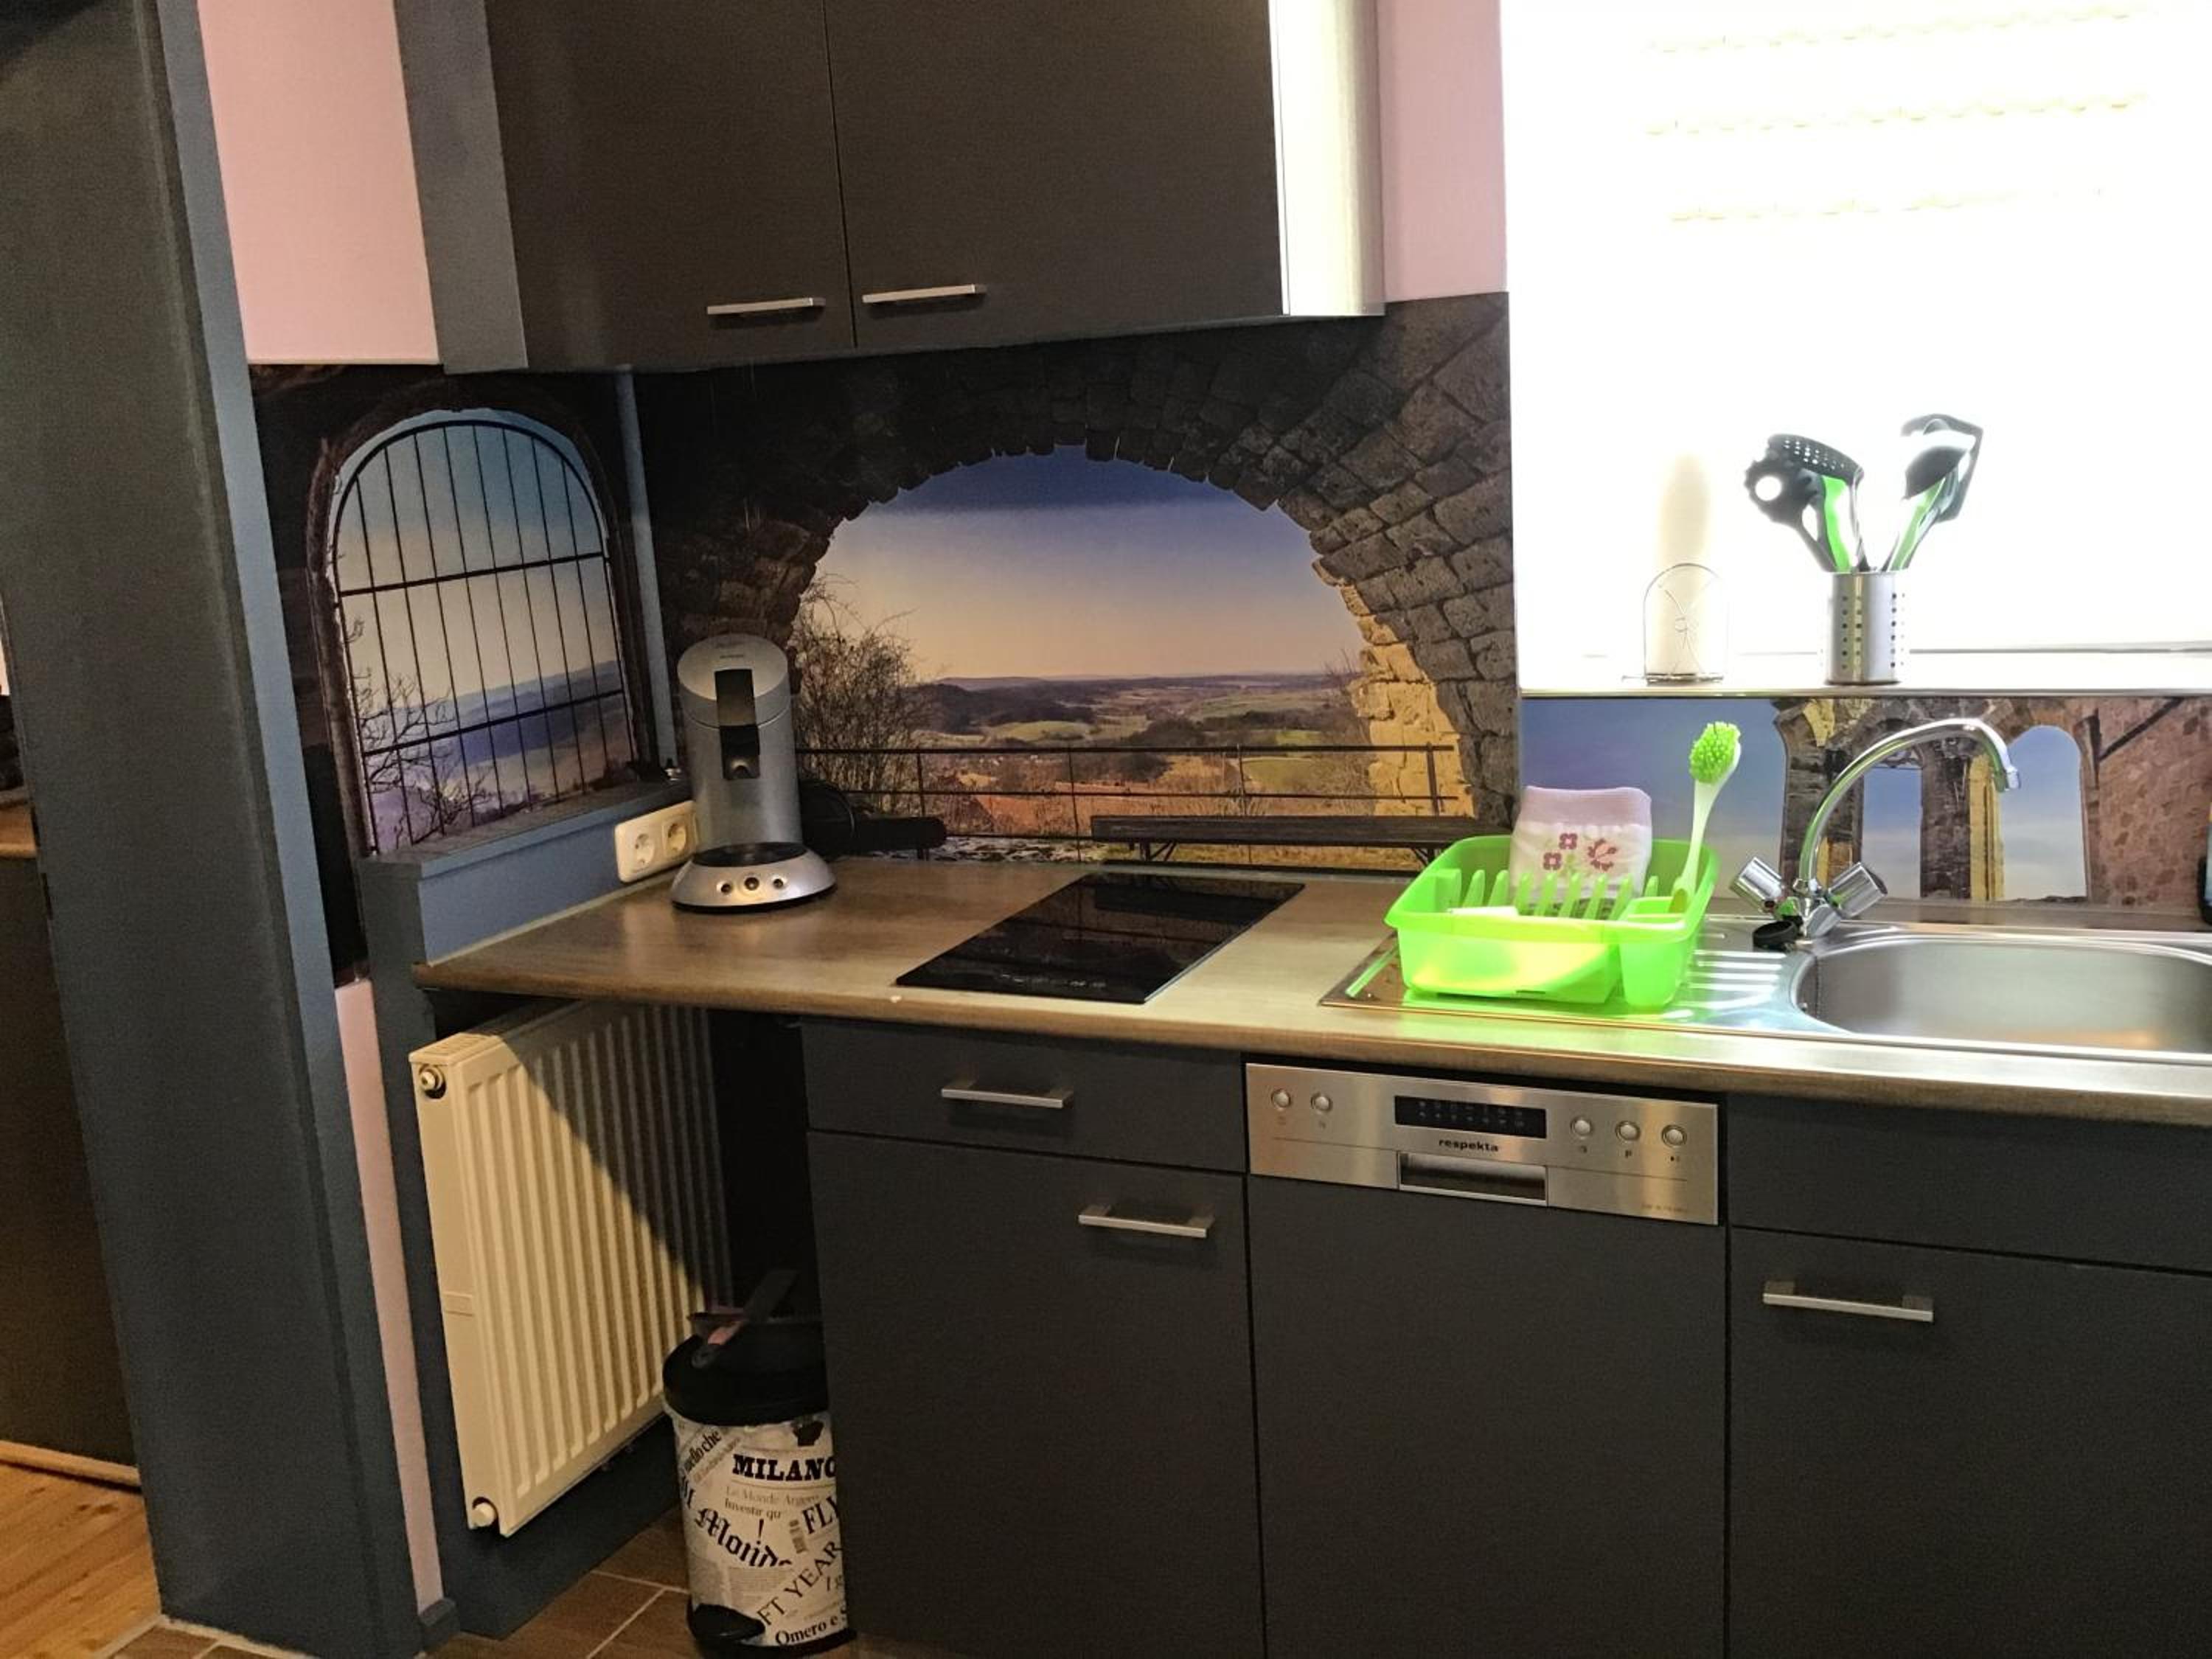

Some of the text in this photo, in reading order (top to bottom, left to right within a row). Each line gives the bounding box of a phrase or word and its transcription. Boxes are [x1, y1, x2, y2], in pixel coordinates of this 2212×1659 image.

[1439, 1139, 1499, 1152] respekta
[732, 1453, 837, 1481] MILANO
[784, 1541, 843, 1599] YEAR
[775, 1620, 827, 1645] Omero
